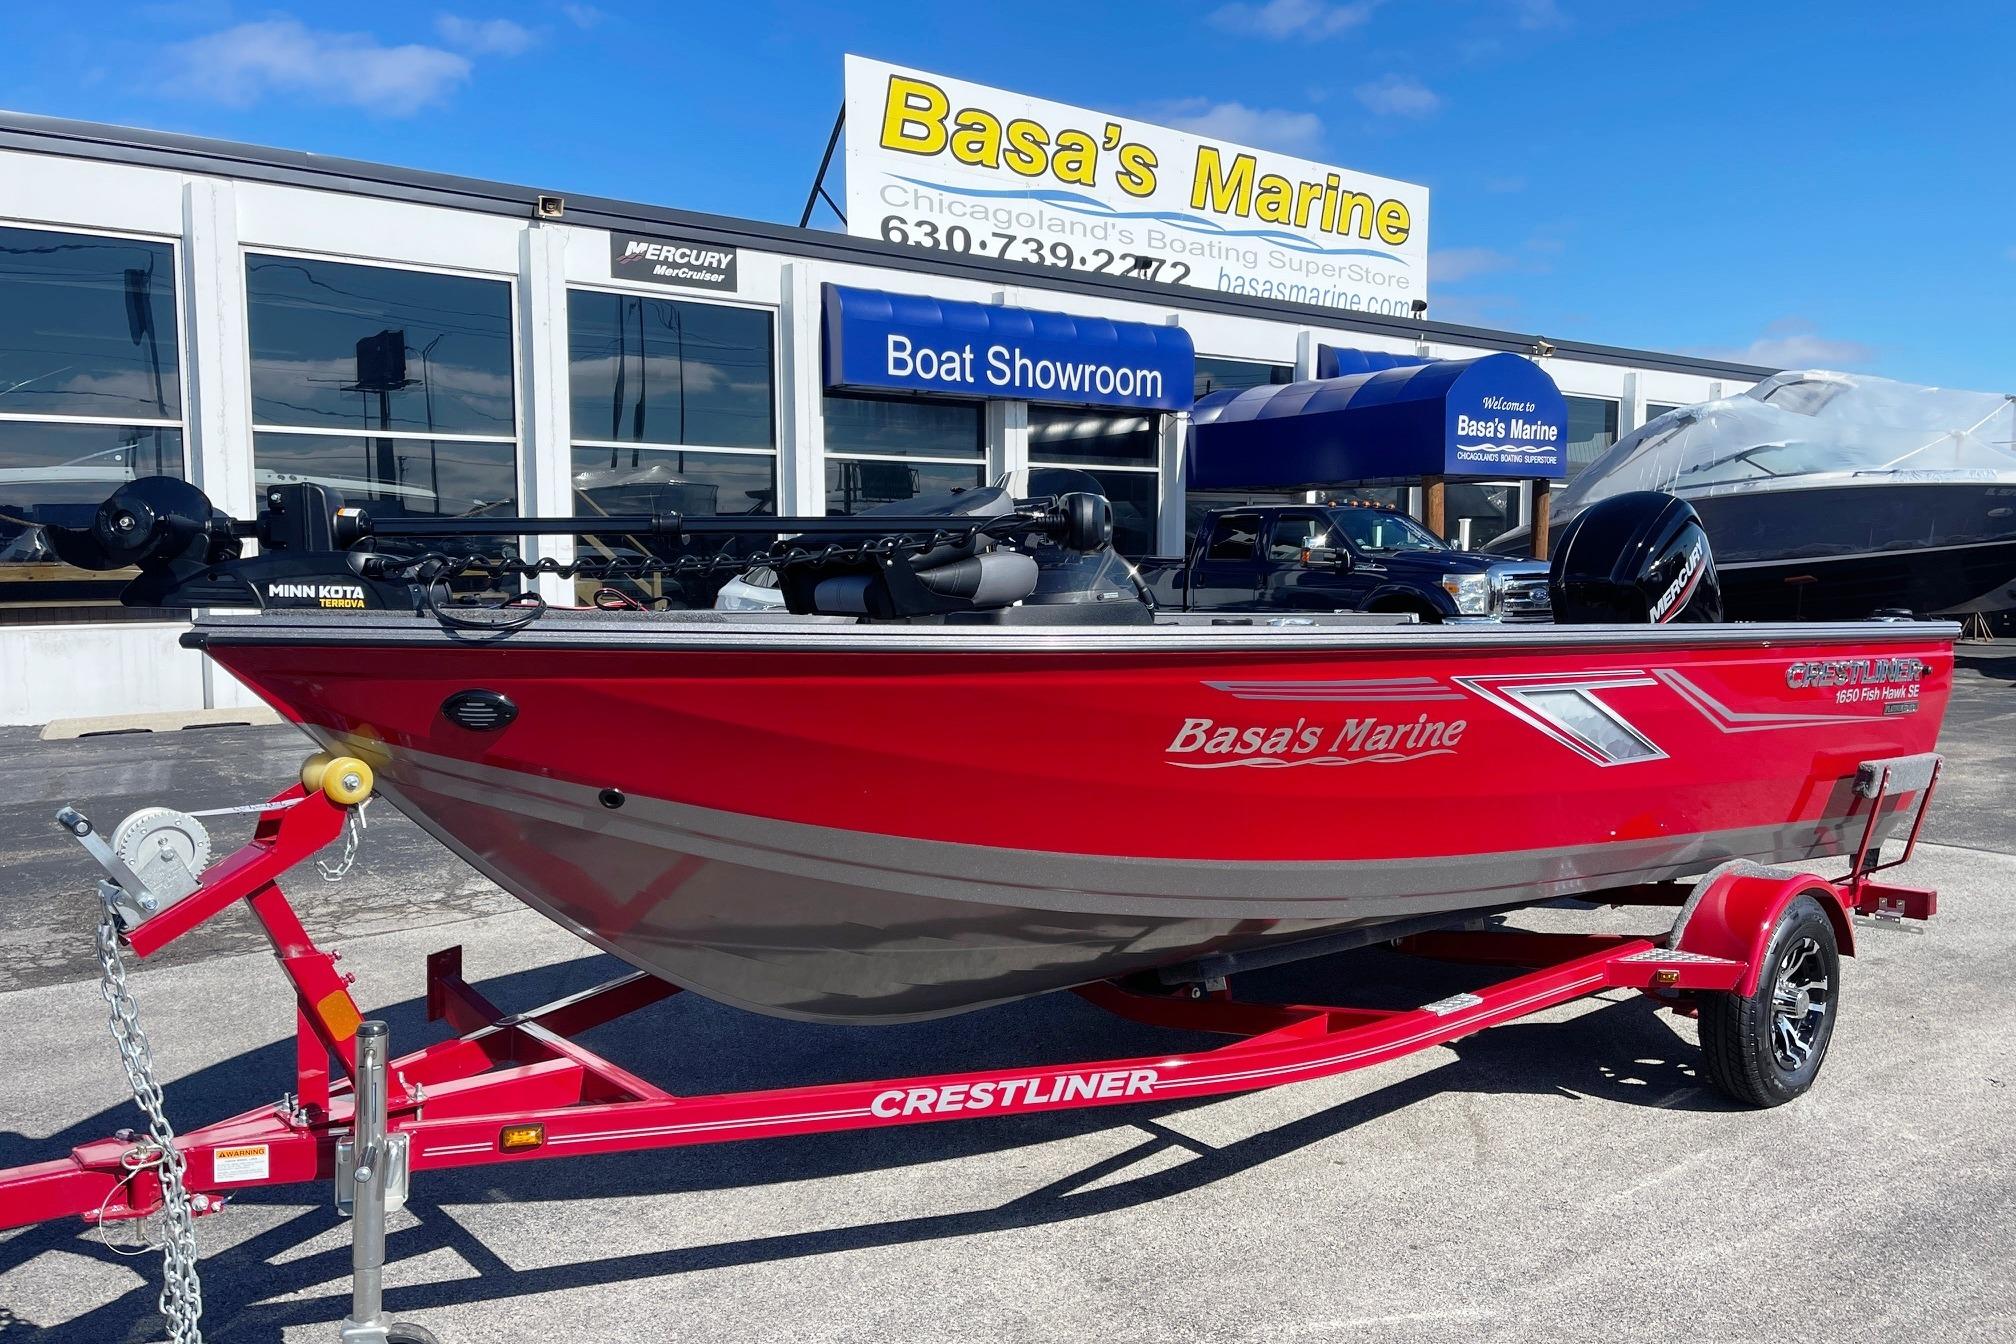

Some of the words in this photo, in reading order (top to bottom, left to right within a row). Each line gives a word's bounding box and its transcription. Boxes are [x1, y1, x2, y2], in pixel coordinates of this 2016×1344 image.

[880, 74, 1159, 198] Basa's
[1189, 145, 1411, 246] Marine
[880, 184, 1134, 245] Chicagoland's
[1147, 229, 1258, 269] Boating
[1268, 250, 1410, 290] SuperStore
[625, 241, 734, 269] MERCURY
[653, 264, 725, 283] MerCruiser
[887, 334, 974, 383] Boat
[986, 344, 1162, 398] Showroom
[1482, 396, 1524, 412] Welcome
[1525, 401, 1535, 412] to
[1457, 415, 1506, 438] Basa's
[1509, 418, 1558, 441] Marine
[1501, 453, 1523, 463] BOATING
[1524, 455, 1558, 465] SUPERSTORE
[268, 584, 316, 598] MINN
[319, 585, 365, 599] KOTA
[1649, 534, 1703, 624] MERCURY
[319, 598, 365, 608] TERROVA
[1785, 657, 1922, 689] CRESTLINER
[1835, 688, 1860, 704] 1650
[1861, 687, 1881, 702] Fish
[1881, 685, 1907, 700] Hawk
[1908, 684, 1920, 698] SE
[1165, 717, 1324, 754] Basa's
[1328, 713, 1468, 752] Marine
[870, 1069, 1159, 1118] CRESTLINER
[226, 1148, 265, 1158] WARNING
